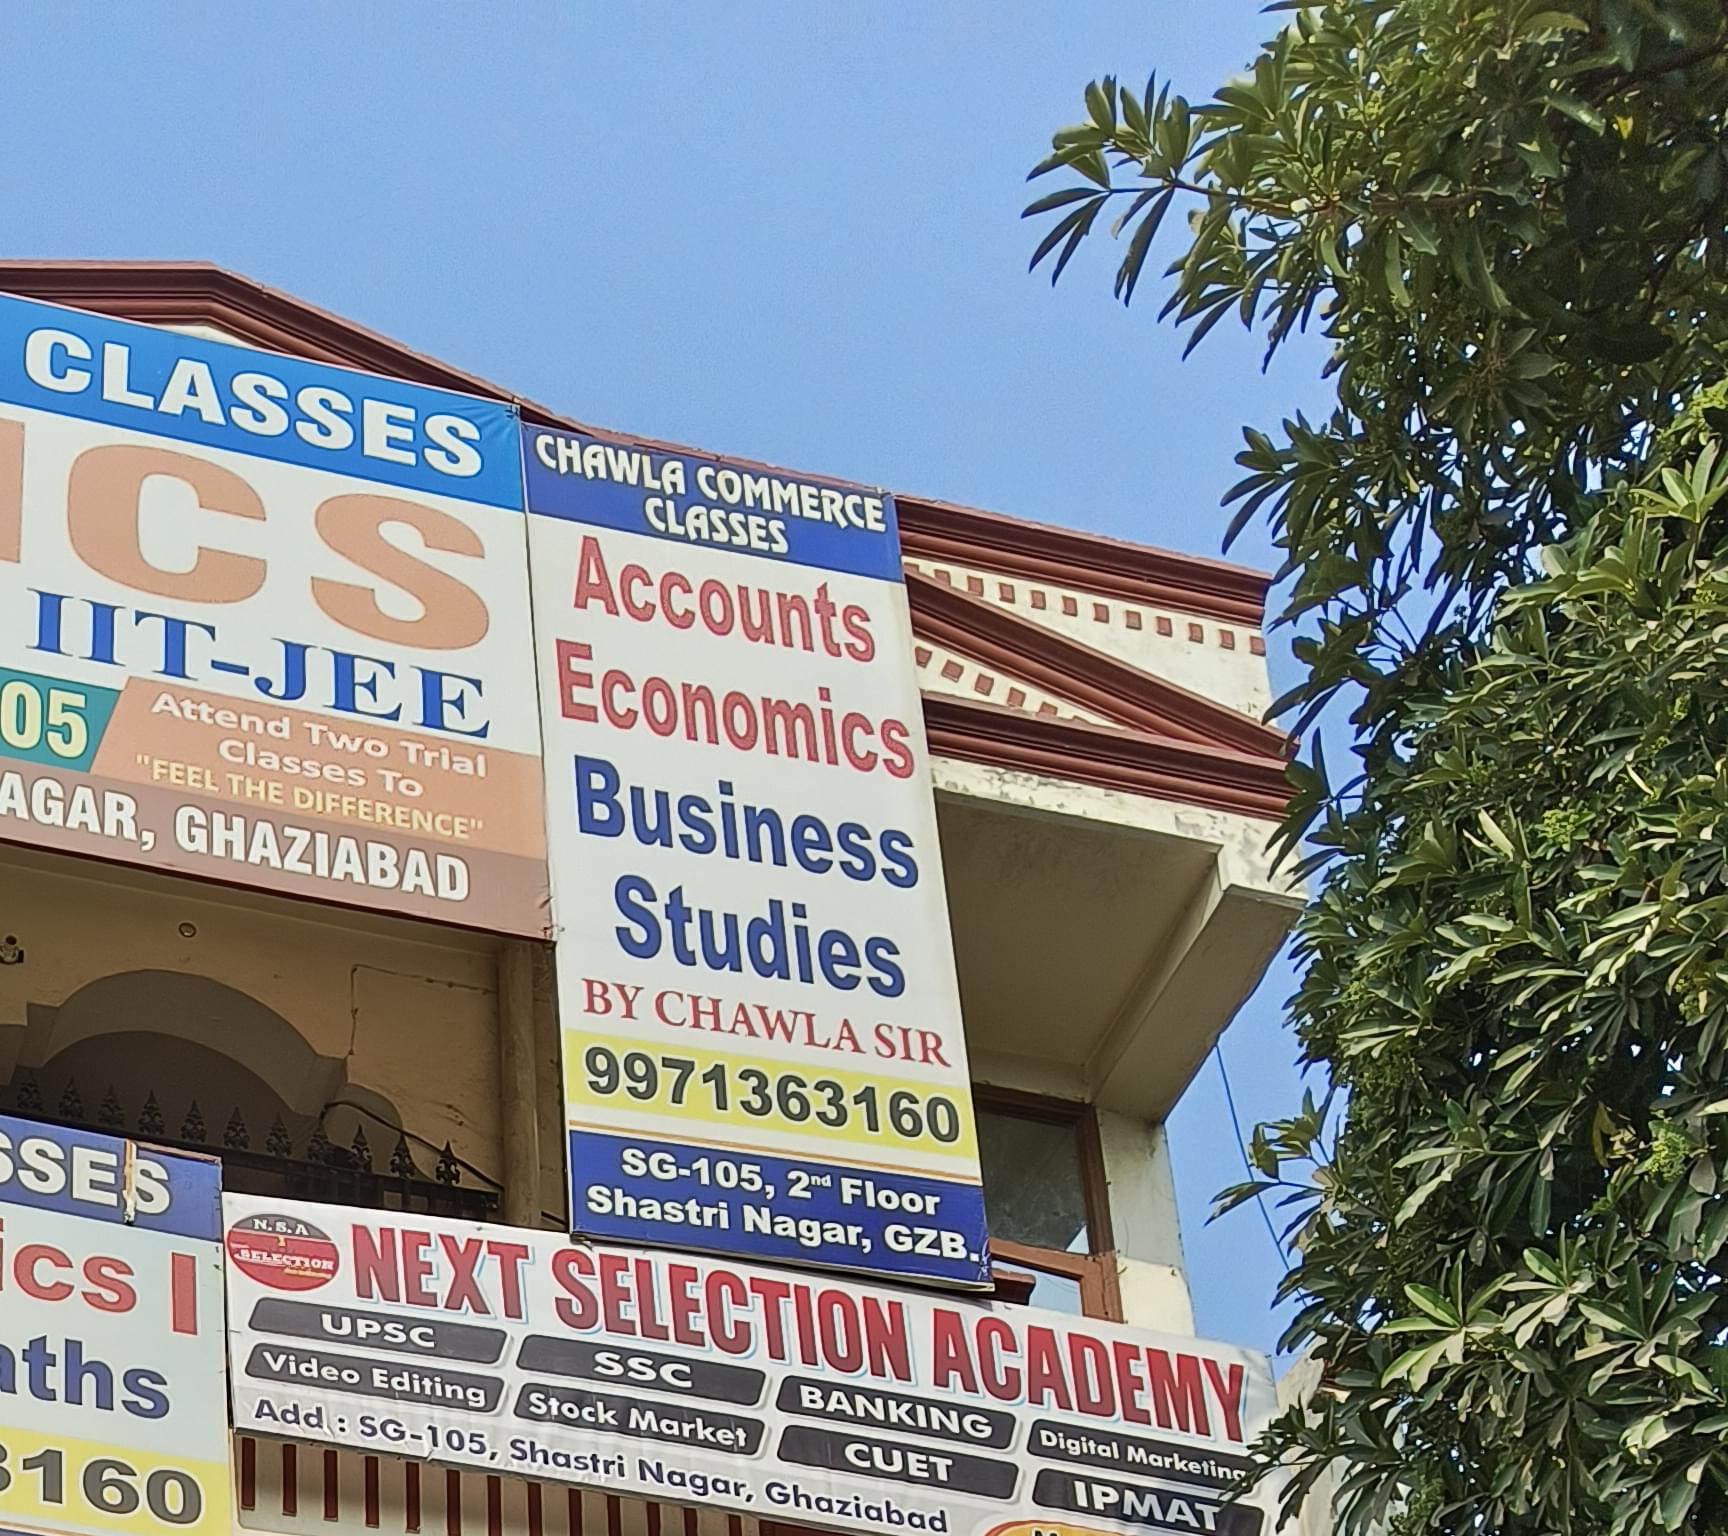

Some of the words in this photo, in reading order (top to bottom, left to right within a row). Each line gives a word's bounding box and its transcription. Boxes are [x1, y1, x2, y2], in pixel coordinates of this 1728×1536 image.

[25, 329, 482, 478] CLASSES
[535, 434, 686, 496] CHAWLA
[697, 465, 887, 533] COMMERCE
[643, 497, 789, 554] CLASSES
[573, 535, 875, 662] Accounts
[25, 588, 490, 739] IIT-JEE
[151, 692, 290, 741] Attend
[303, 722, 389, 758] Two
[400, 737, 487, 778] Trial
[555, 638, 915, 778] Economics
[218, 741, 366, 788] Classes
[227, 775, 284, 806] THE
[293, 785, 483, 840] DIFFERENCE"
[574, 754, 919, 889] Business
[174, 805, 471, 901] GHAZIABAD
[614, 874, 906, 998] Studies
[581, 978, 644, 1019] BY
[654, 990, 865, 1055] CHAWLA
[874, 1024, 951, 1068] SIR
[584, 1046, 960, 1145] 9971363160
[621, 1148, 776, 1199] SG-105,
[840, 1177, 941, 1216] Floor
[240, 1249, 334, 1270] SELECTION
[587, 1186, 731, 1230] Shastri
[743, 1206, 872, 1254] Nagar,
[885, 1216, 980, 1263] GZB.
[321, 1313, 436, 1349] UPSC
[350, 1223, 529, 1321] NEXT
[551, 1247, 912, 1383] SELECTION
[932, 1307, 1245, 1443] ACADEMY
[263, 1351, 360, 1384] Video
[372, 1368, 487, 1407] Editing
[593, 1352, 693, 1388] SSC
[529, 1391, 617, 1426] Stock
[629, 1408, 749, 1450] Market
[800, 1385, 994, 1440] BANKING
[1039, 1431, 1120, 1460] Digital
[510, 1438, 626, 1480] Shastri
[638, 1458, 754, 1504] Nagar,
[766, 1482, 949, 1534] Ghaziabad
[845, 1442, 953, 1482] CUET
[1073, 1480, 1220, 1532] IPMAT
